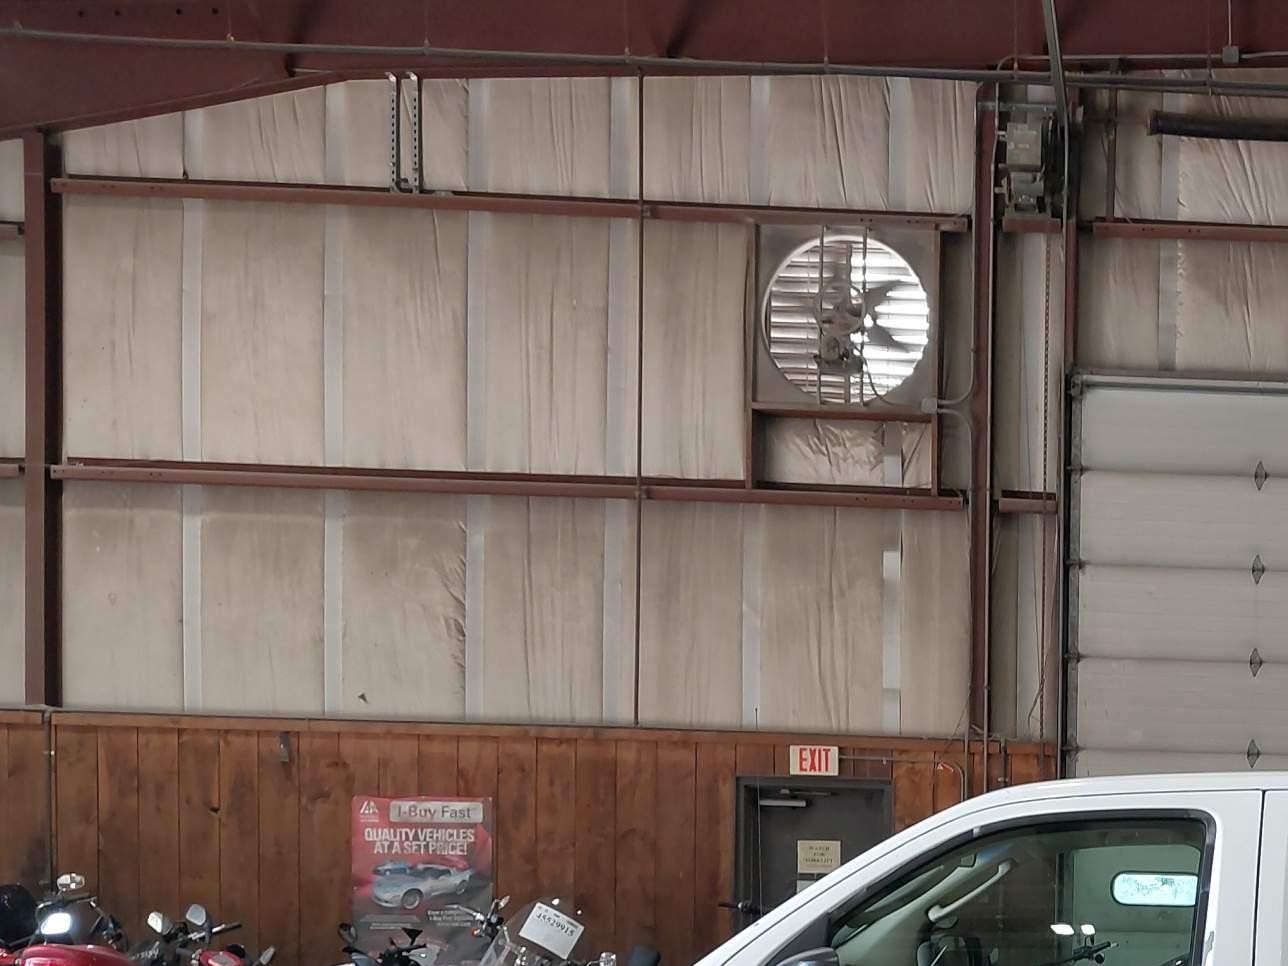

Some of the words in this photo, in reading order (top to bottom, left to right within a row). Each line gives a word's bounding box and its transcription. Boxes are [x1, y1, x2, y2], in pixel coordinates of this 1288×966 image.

[799, 748, 831, 772] EXIT
[397, 805, 436, 819] I-Buy
[441, 805, 471, 818] Fast
[364, 828, 415, 841] QUALITY
[417, 828, 475, 842] VEHICLES
[374, 842, 390, 854] AT
[391, 842, 401, 854] A
[403, 842, 427, 854] SET
[428, 842, 468, 855] PRICE!
